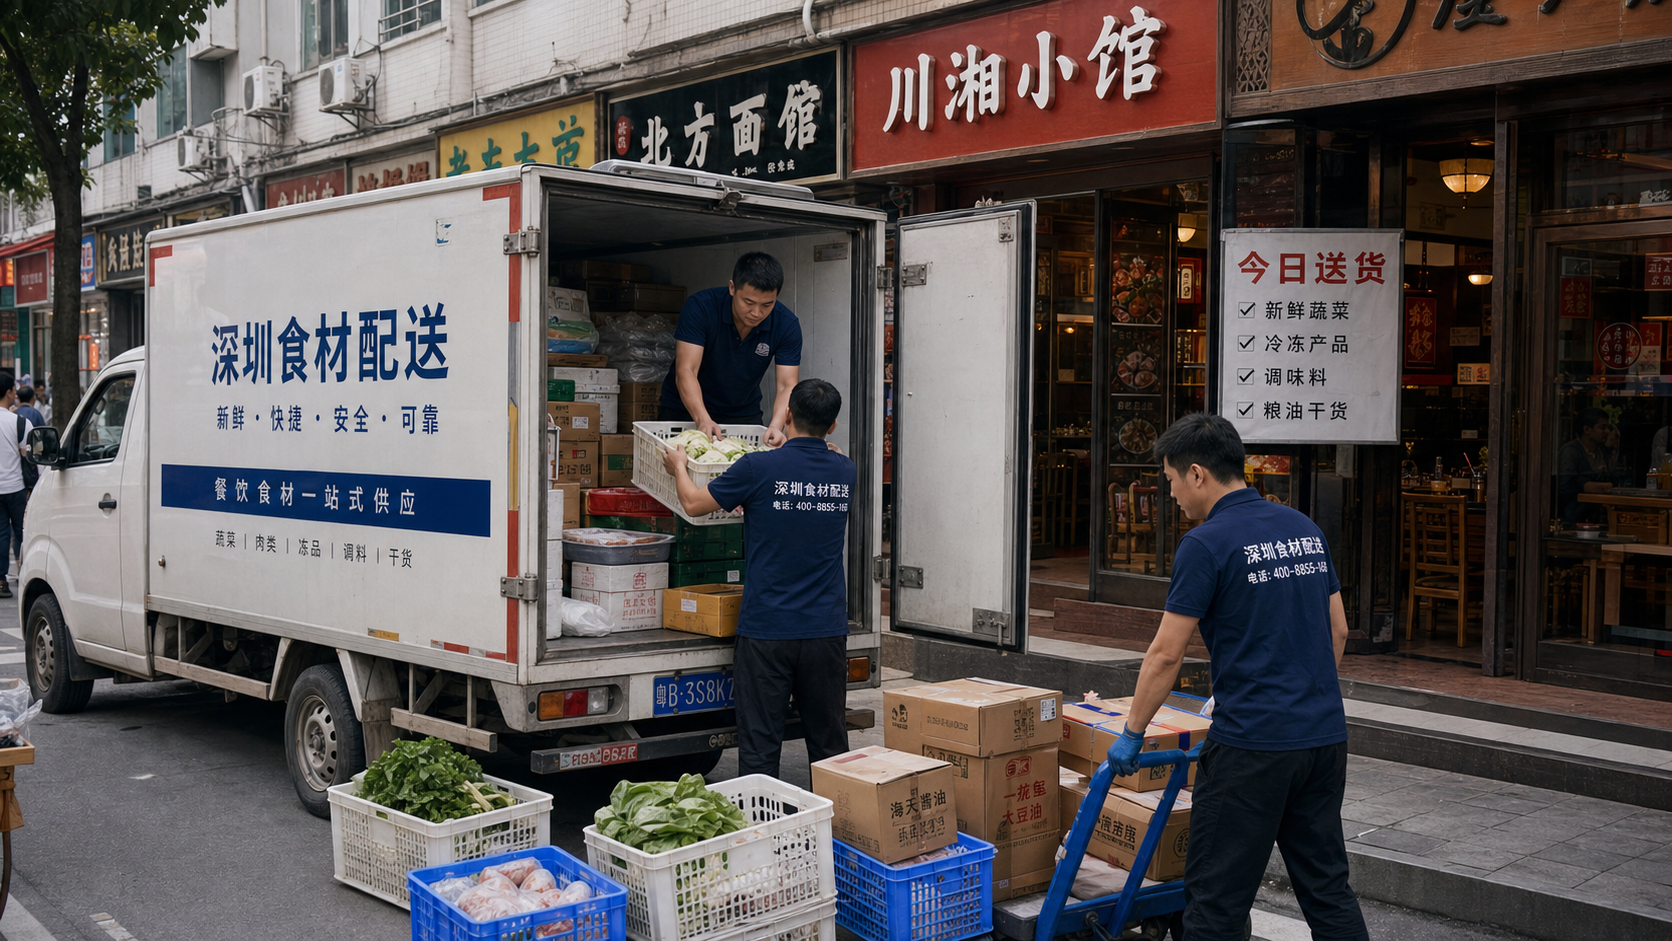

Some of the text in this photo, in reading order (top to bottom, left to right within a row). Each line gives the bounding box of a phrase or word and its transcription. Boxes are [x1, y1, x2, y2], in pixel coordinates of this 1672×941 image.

[884, 5, 1165, 132] 川湘小馆
[640, 79, 822, 168] 北方面馆
[1237, 250, 1387, 285] 今日送货
[1265, 300, 1350, 321] 新鲜蔬菜
[211, 302, 449, 386] 深圳食材配送
[1264, 334, 1349, 354] 冷冻产品
[1264, 367, 1327, 387] 调味料
[217, 404, 439, 435] 新鲜 快捷 安全 可靠
[1263, 400, 1348, 421] 粮油干货
[214, 476, 416, 517] 餐饮食材一站式供应
[774, 480, 850, 499] 深圳食材配送
[215, 529, 236, 548] 蔬菜
[255, 533, 277, 553] 肉类
[343, 541, 368, 563] 调料
[388, 547, 413, 569] 干货
[1243, 536, 1325, 565] 深圳食材配送
[1002, 802, 1042, 825] 大豆油
